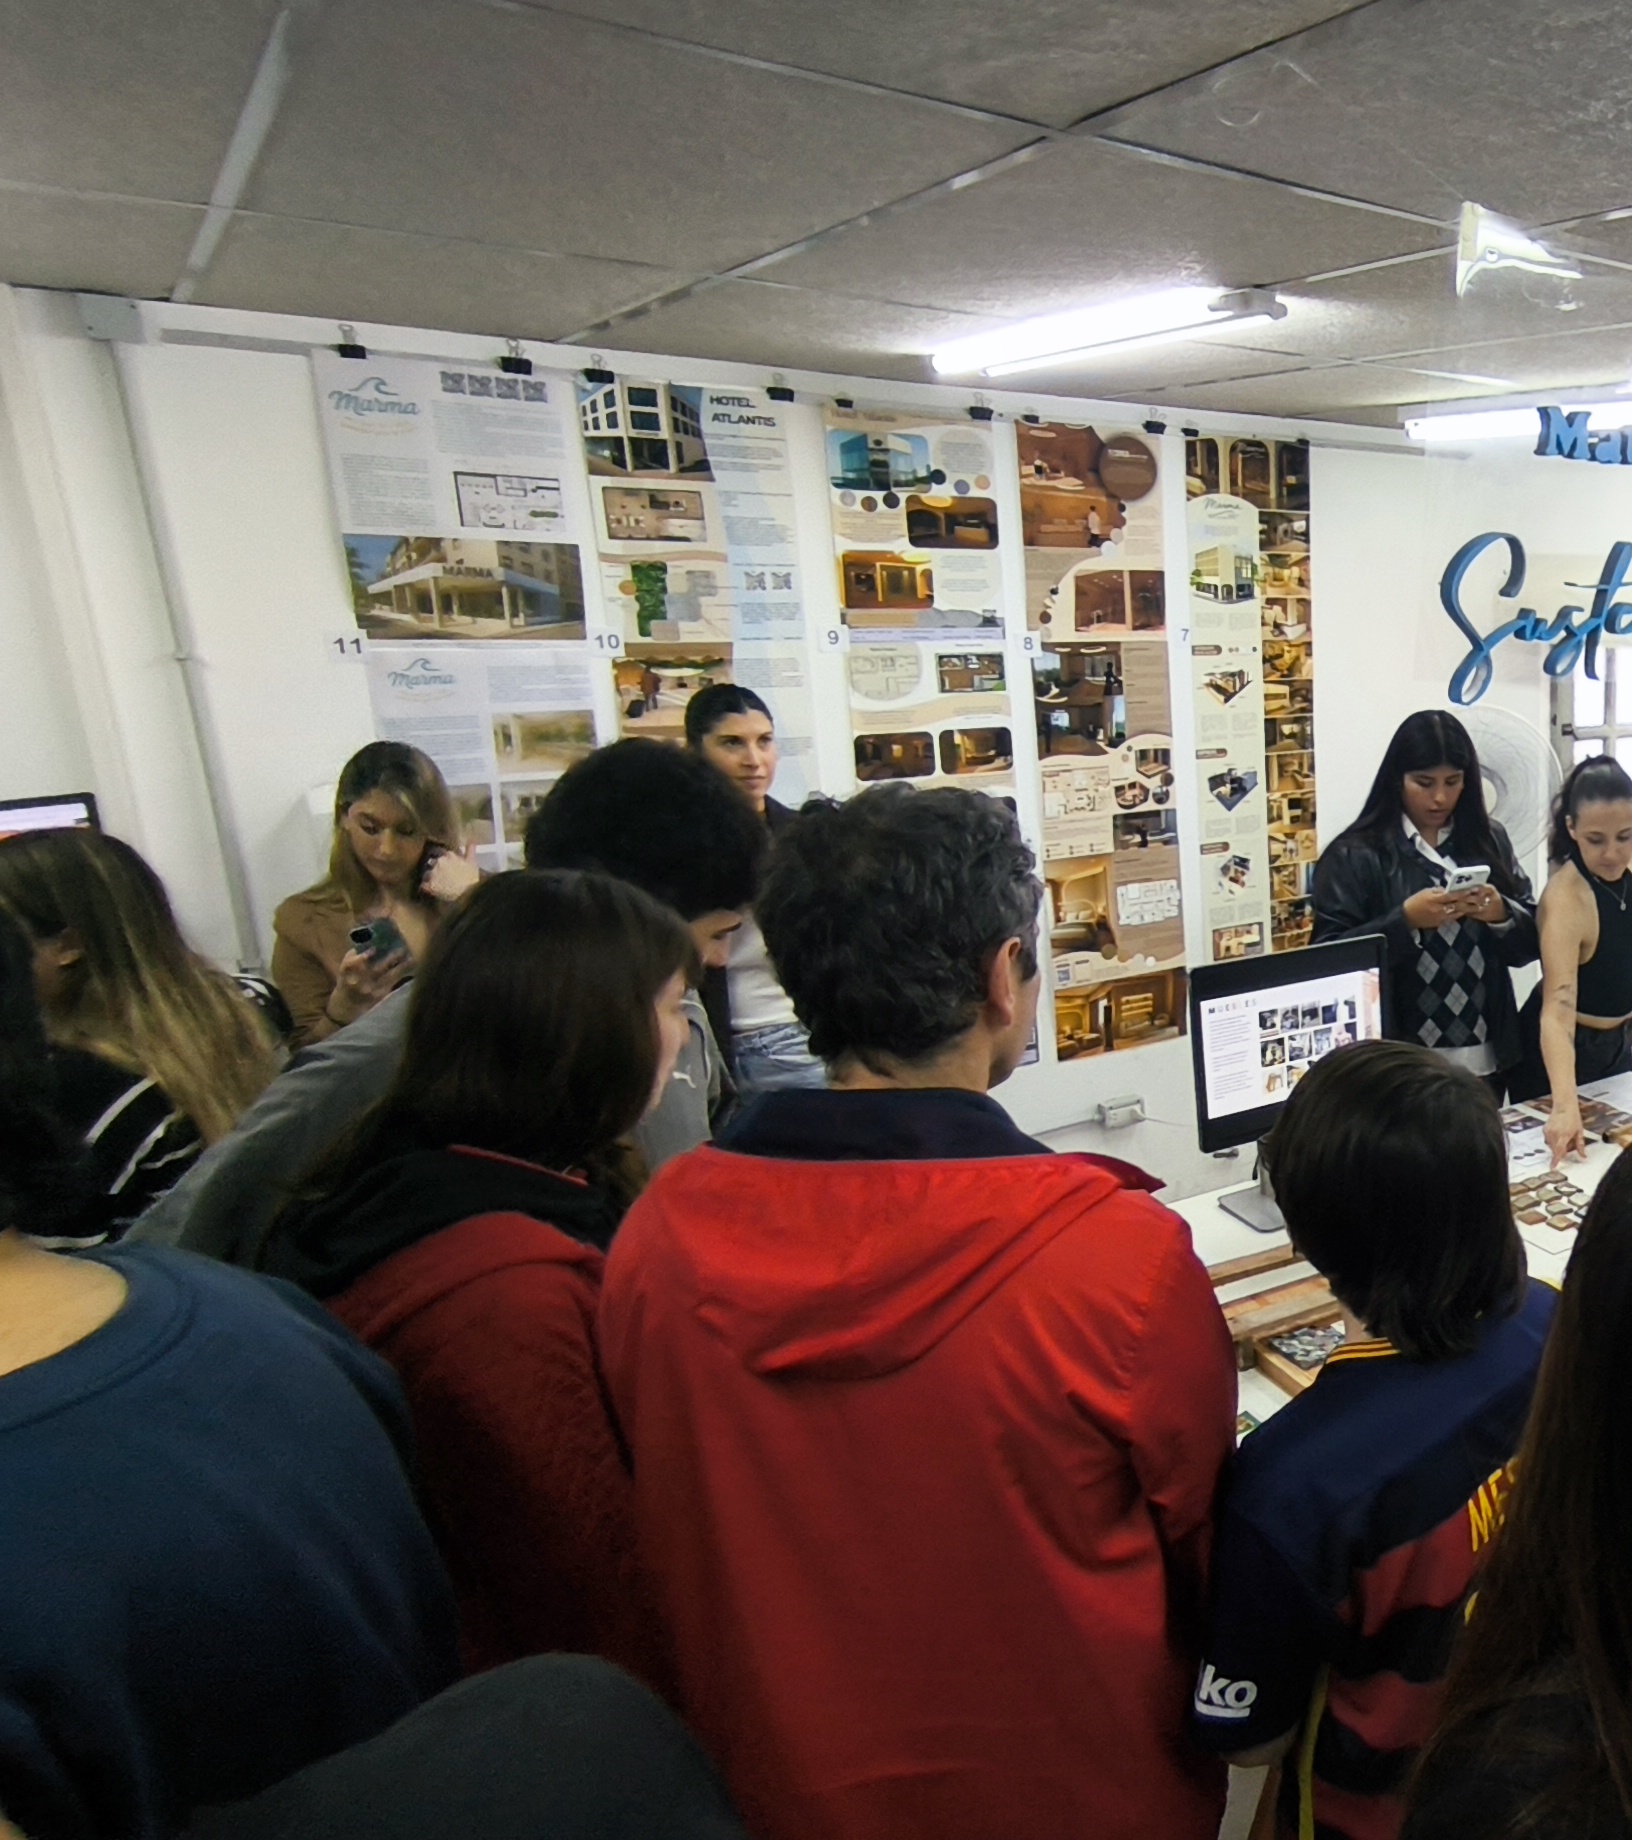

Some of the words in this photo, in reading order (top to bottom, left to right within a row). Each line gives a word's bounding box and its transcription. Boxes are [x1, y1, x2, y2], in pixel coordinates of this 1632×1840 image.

[709, 395, 757, 408] HOTEL
[711, 412, 776, 427] ATLANTIS
[594, 634, 620, 650] 10
[827, 630, 840, 645] 9
[1180, 628, 1190, 642] 7
[333, 637, 362, 655] 11
[1023, 636, 1034, 650] 8
[1199, 1664, 1258, 1708] ko
